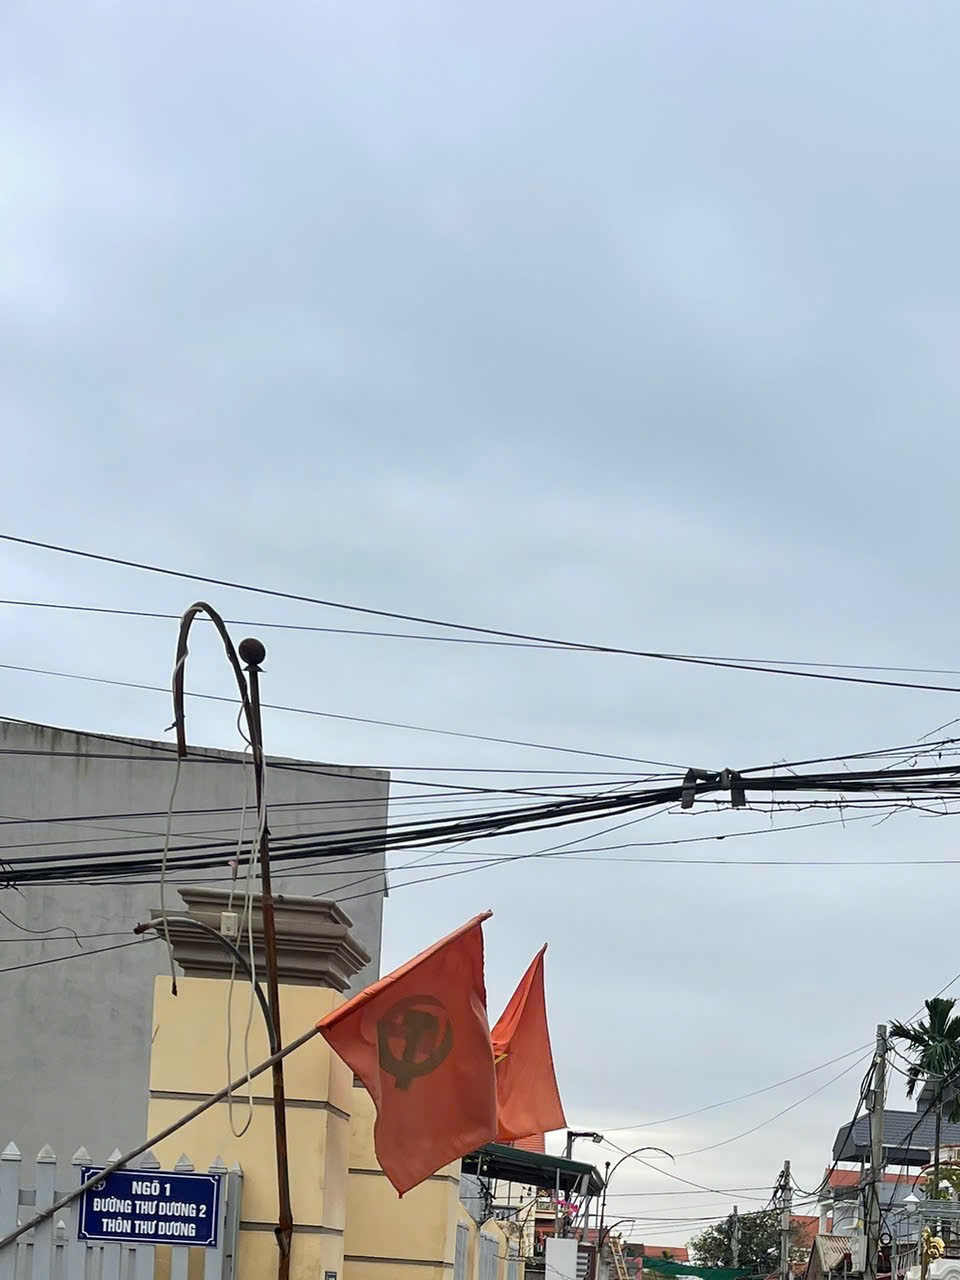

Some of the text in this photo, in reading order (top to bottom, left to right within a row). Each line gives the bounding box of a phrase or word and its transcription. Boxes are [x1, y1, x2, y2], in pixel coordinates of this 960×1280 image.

[132, 1180, 171, 1196] NGÕ 1
[93, 1196, 206, 1218] ĐƯỜNG THƯ DƯƠNG 2
[102, 1217, 196, 1237] THÔN THƯ DƯƠNG
